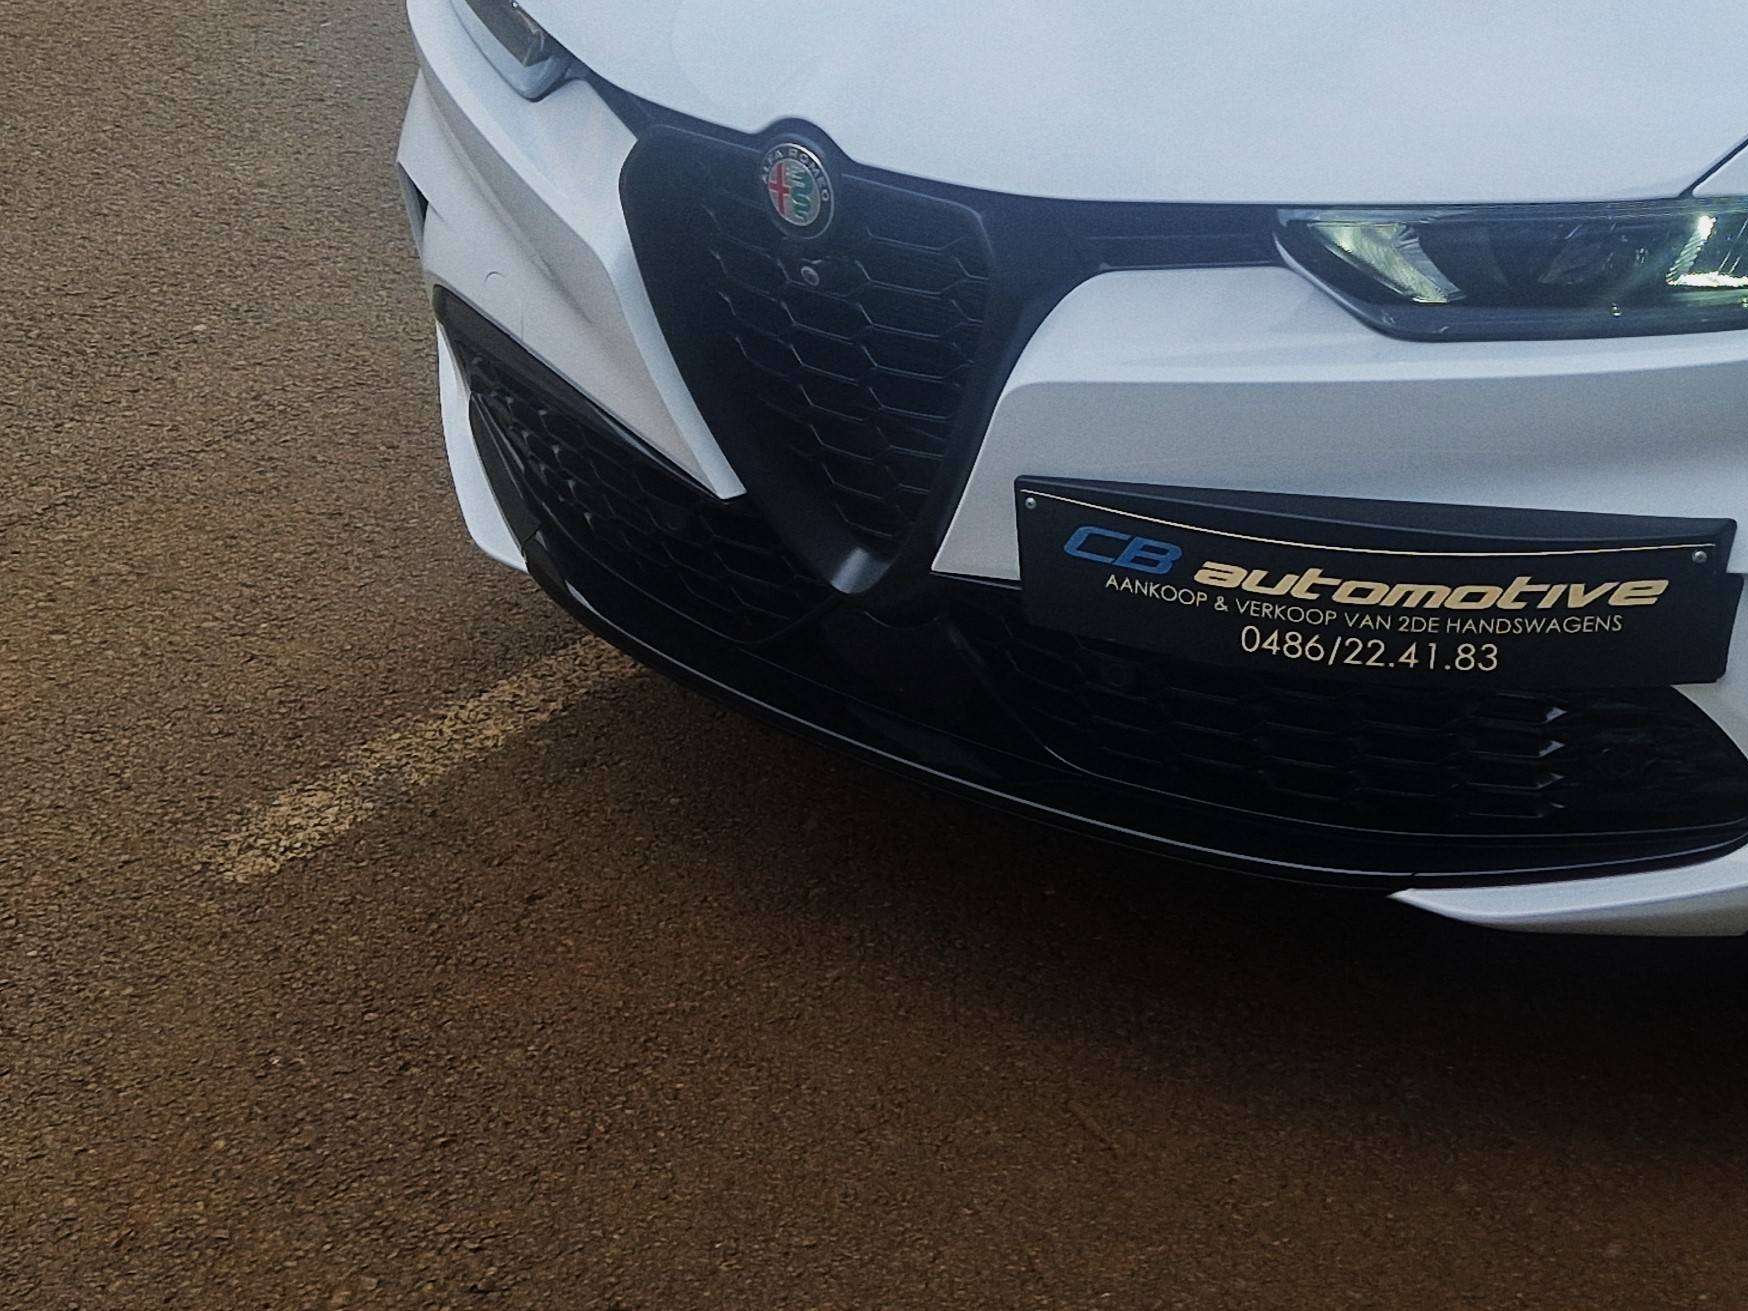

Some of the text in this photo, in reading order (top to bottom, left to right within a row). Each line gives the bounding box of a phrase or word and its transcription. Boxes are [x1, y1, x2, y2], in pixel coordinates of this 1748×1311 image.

[788, 148, 830, 202] ROMEO
[1064, 526, 1669, 610] CB automotive
[1105, 574, 1624, 635] AANKOOP & VERKOOP VAN 2DE HANDSWAGENS
[1240, 625, 1499, 672] 0486/22.41.83
